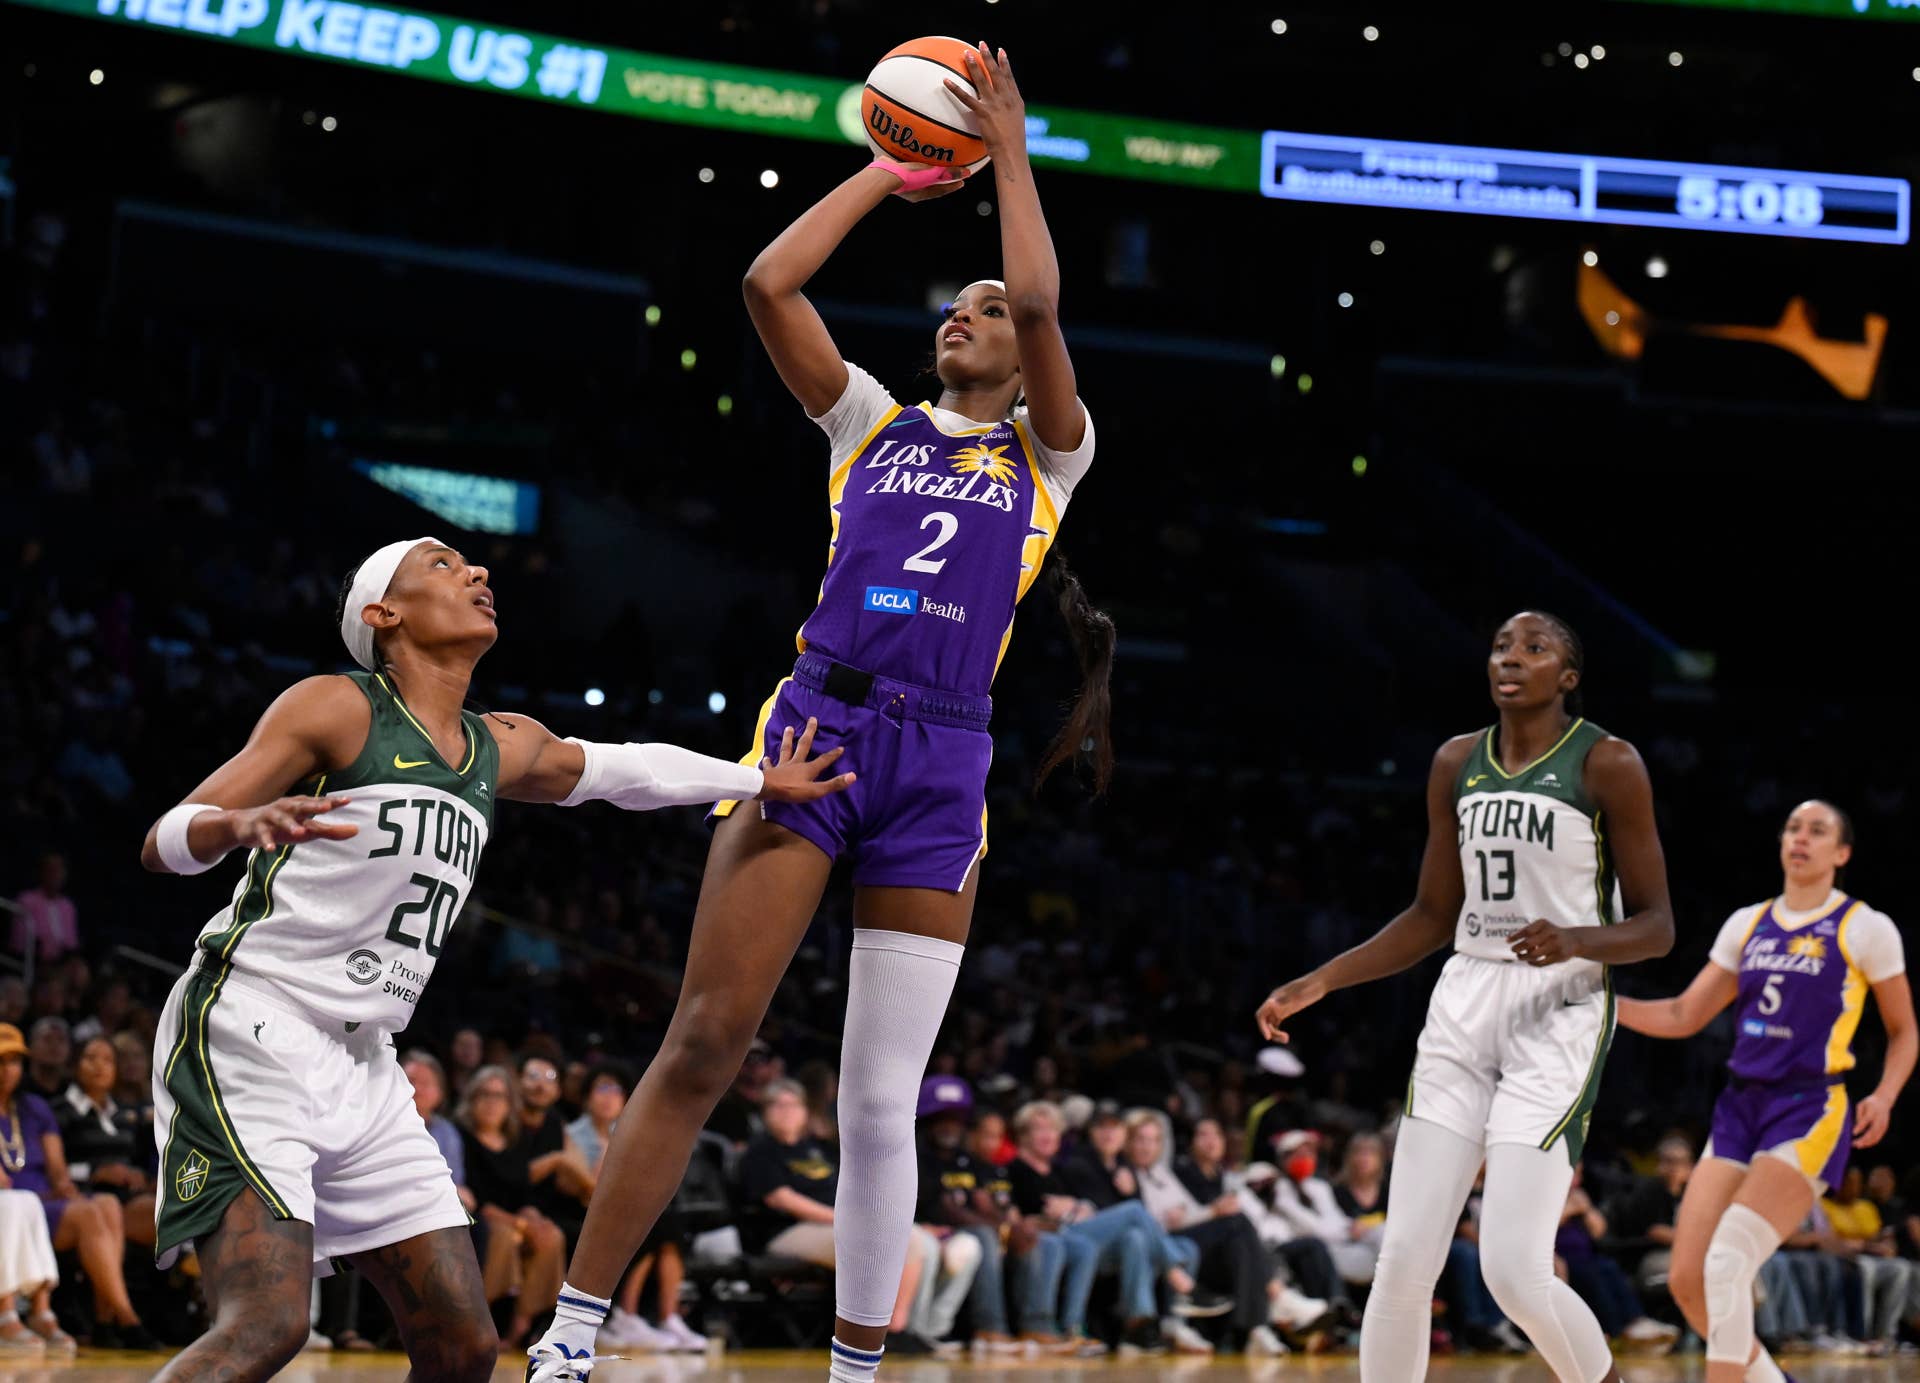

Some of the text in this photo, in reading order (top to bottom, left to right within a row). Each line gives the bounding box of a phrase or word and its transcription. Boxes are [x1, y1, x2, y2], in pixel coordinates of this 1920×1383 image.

[275, 0, 440, 68] KEEP
[448, 25, 533, 89] US
[536, 43, 608, 103] #1
[624, 67, 820, 122] VOTE TODAY
[870, 103, 954, 162] Wilson
[1677, 175, 1824, 228] 5:08
[866, 466, 1018, 512] ANGELES
[903, 511, 959, 575] 2
[872, 593, 911, 609] UCLA
[1475, 850, 1515, 901] 13
[385, 872, 459, 958] 20
[1757, 974, 1786, 1016] 5
